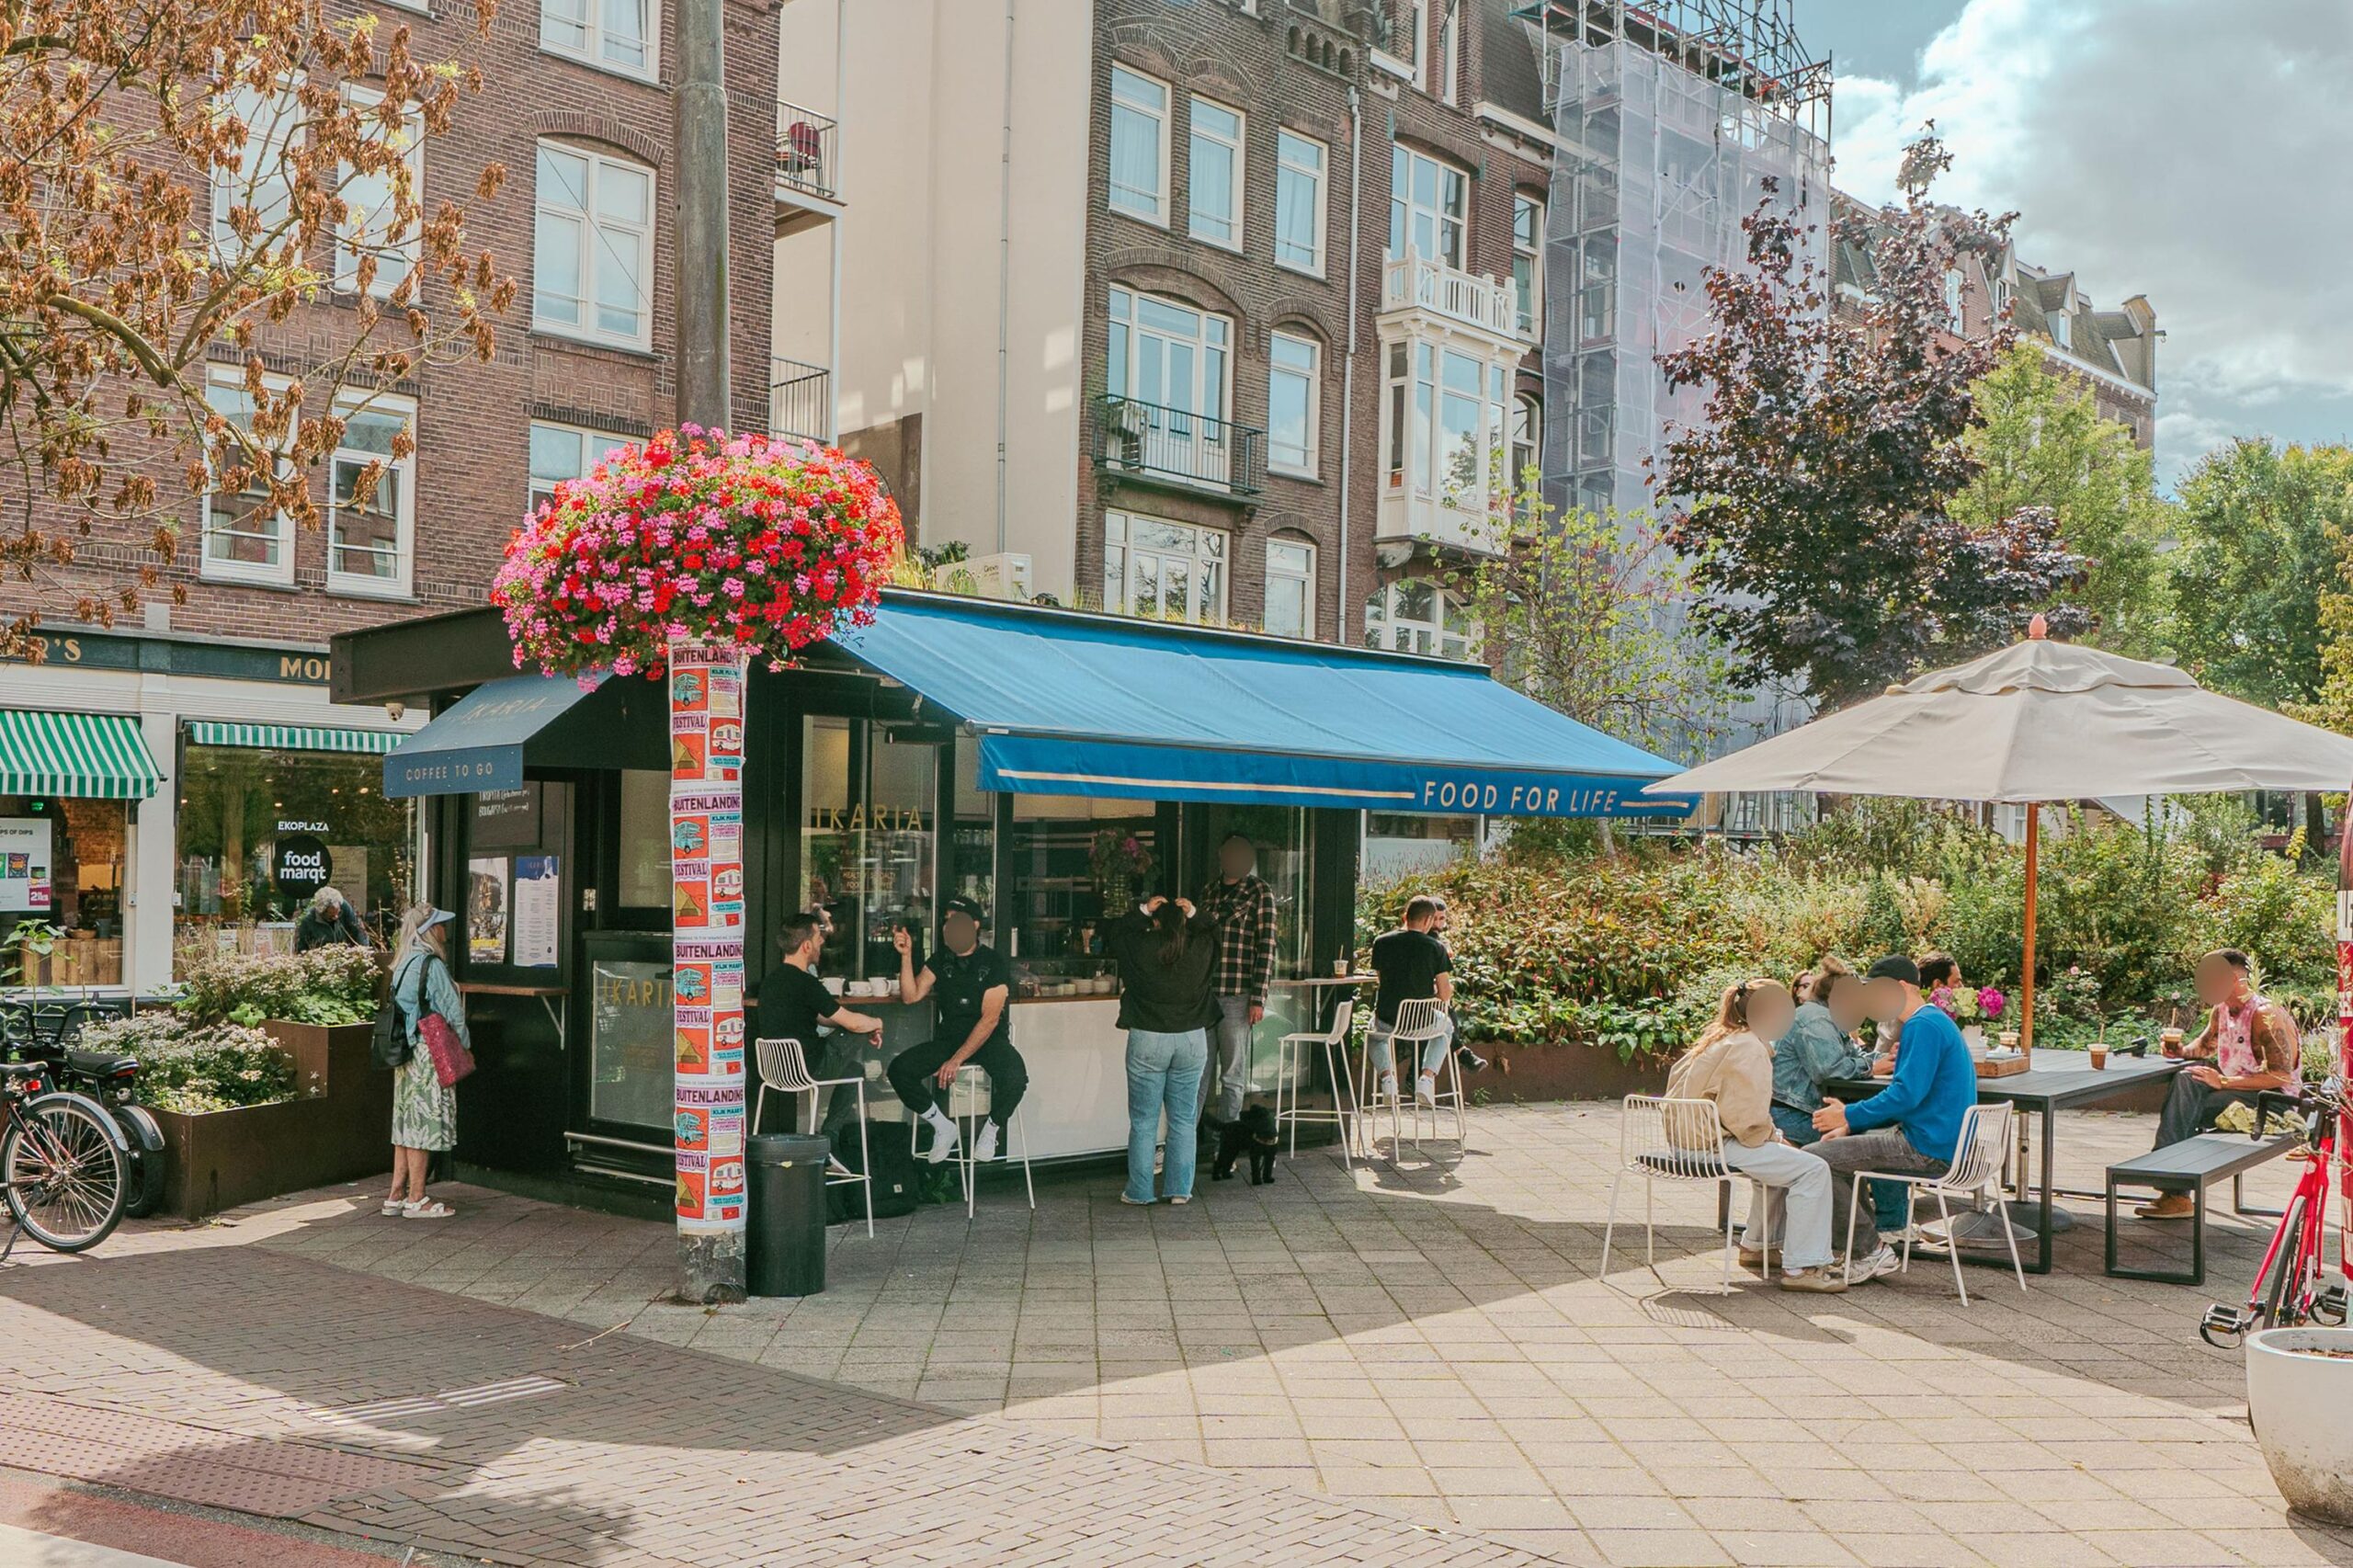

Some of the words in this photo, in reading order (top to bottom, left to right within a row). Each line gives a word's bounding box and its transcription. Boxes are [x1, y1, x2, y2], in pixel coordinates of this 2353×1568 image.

[673, 715, 707, 729] FESTIVAL
[405, 766, 448, 780] COFFEE
[455, 765, 469, 777] TO
[476, 762, 493, 776] GO
[1424, 781, 1498, 809] FOOD
[1510, 786, 1560, 812] FOR
[1569, 790, 1619, 812] LIFE
[816, 802, 923, 831] IKARIA
[278, 821, 329, 832] EKOPLAZA
[284, 850, 321, 867] food
[279, 866, 326, 884] marqt
[675, 863, 708, 876] FESTIVAL
[676, 1010, 710, 1023] FESTIVAL
[676, 1153, 706, 1167] FESTIVAL
